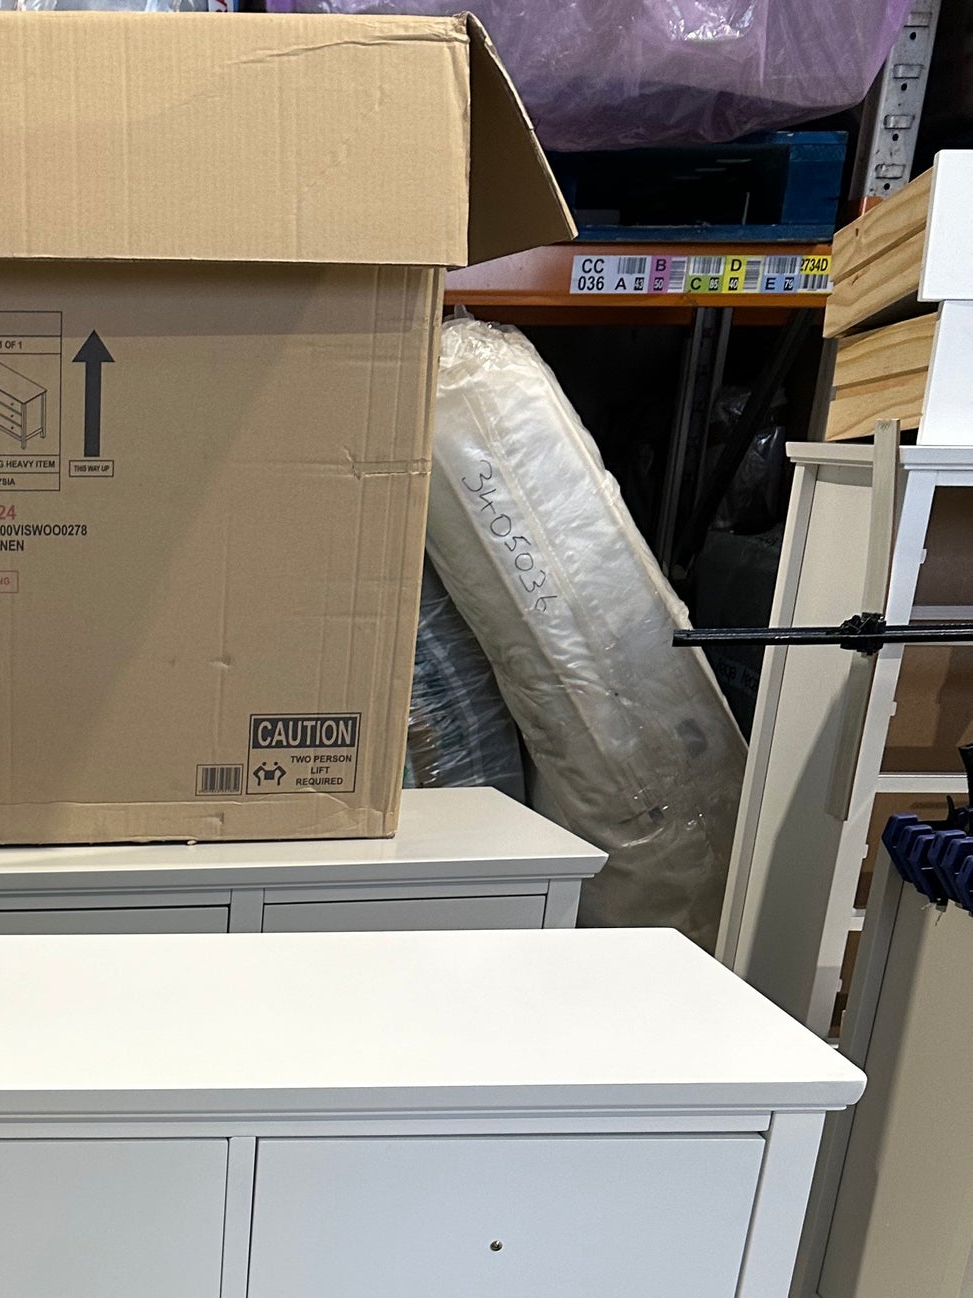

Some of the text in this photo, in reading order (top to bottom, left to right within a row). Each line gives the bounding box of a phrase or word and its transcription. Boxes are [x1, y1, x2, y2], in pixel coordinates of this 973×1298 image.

[581, 258, 605, 273] CC
[655, 258, 667, 271] B
[730, 259, 742, 272] D
[578, 275, 605, 291] 036
[615, 277, 627, 290] A
[690, 277, 703, 290] C
[765, 277, 778, 290] E
[4, 339, 16, 349] OF
[5, 459, 34, 469] HEAVY
[35, 459, 56, 469] ITEM
[73, 464, 110, 473] THIS WAY UP
[257, 719, 352, 747] CAUTION
[290, 754, 352, 764] TWO PERSON
[310, 766, 330, 775] LIFT
[295, 777, 343, 786] REQUIRED
